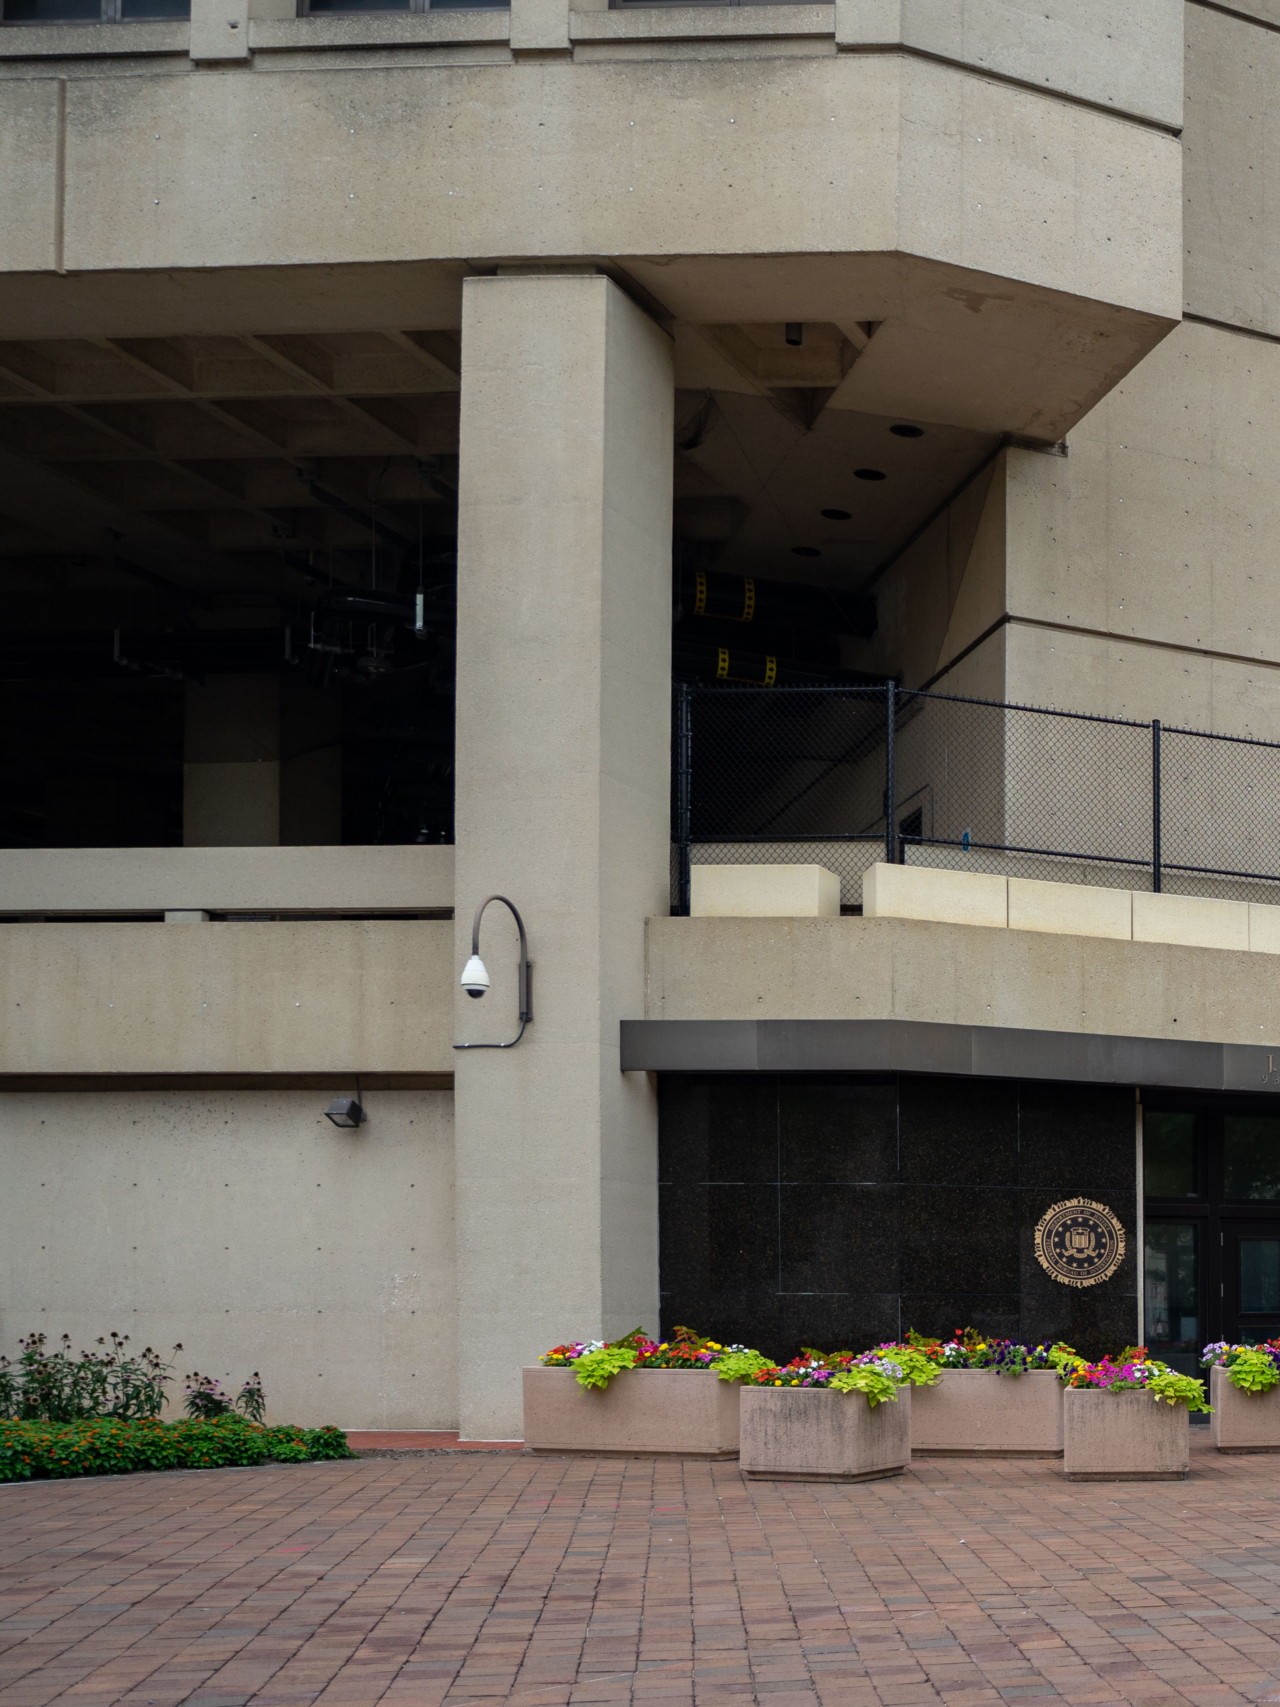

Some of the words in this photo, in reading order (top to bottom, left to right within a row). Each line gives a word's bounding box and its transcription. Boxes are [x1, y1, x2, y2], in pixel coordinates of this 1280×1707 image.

[1267, 1054, 1277, 1073] J.
[1049, 1209, 1081, 1230] DEPARTMENT
[1093, 1214, 1111, 1231] JUSTICE
[1045, 1238, 1057, 1263] FEDERAL
[1056, 1263, 1079, 1276] BUREAU
[1089, 1240, 1115, 1274] INVESTIGATION
